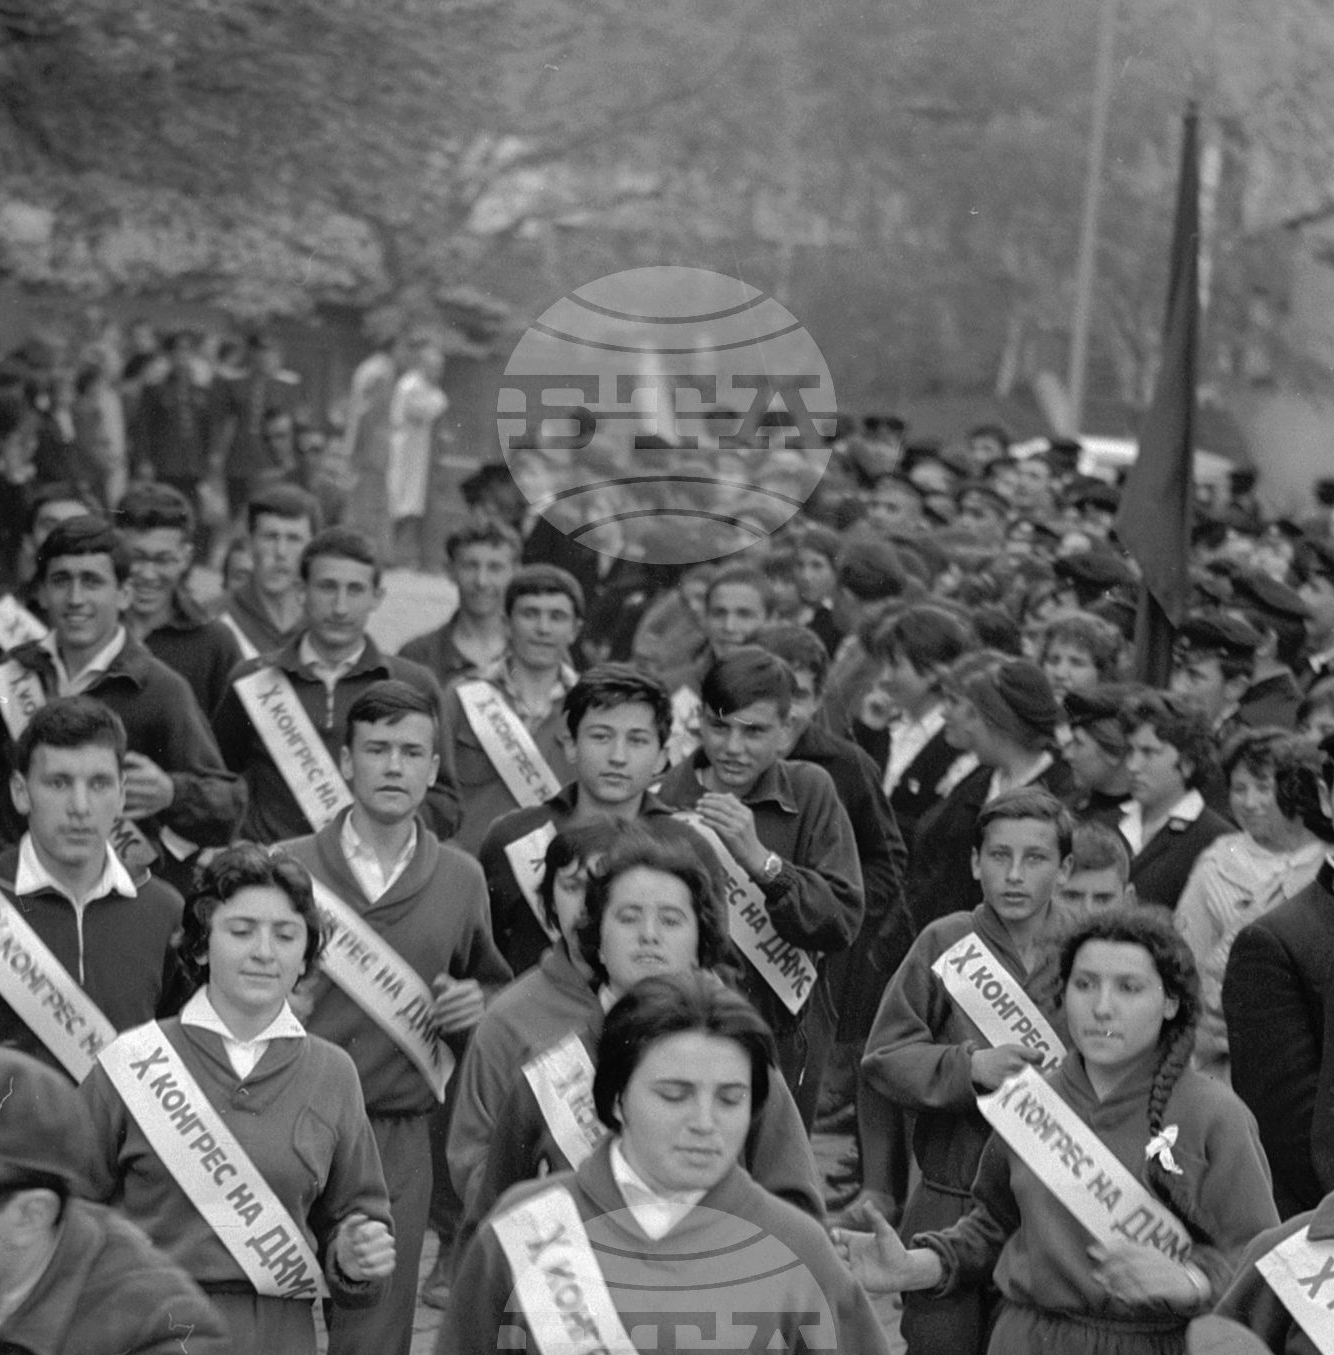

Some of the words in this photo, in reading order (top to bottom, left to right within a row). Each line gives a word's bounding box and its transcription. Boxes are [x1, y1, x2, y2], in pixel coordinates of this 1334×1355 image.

[270, 702, 323, 783] КОНГРЕС
[316, 781, 339, 811] НА
[739, 902, 768, 935] НА
[754, 934, 813, 1000] ДКМС
[949, 943, 983, 975] X
[78, 1026, 105, 1060] Н
[129, 1046, 170, 1081] X
[149, 1073, 238, 1187] КОНГРЕС
[1013, 1091, 1096, 1180] КОНГРЕС
[1086, 1172, 1123, 1214] НА
[1110, 1204, 1193, 1265] ДКМ
[226, 1183, 265, 1228] НА
[524, 1221, 572, 1266] X
